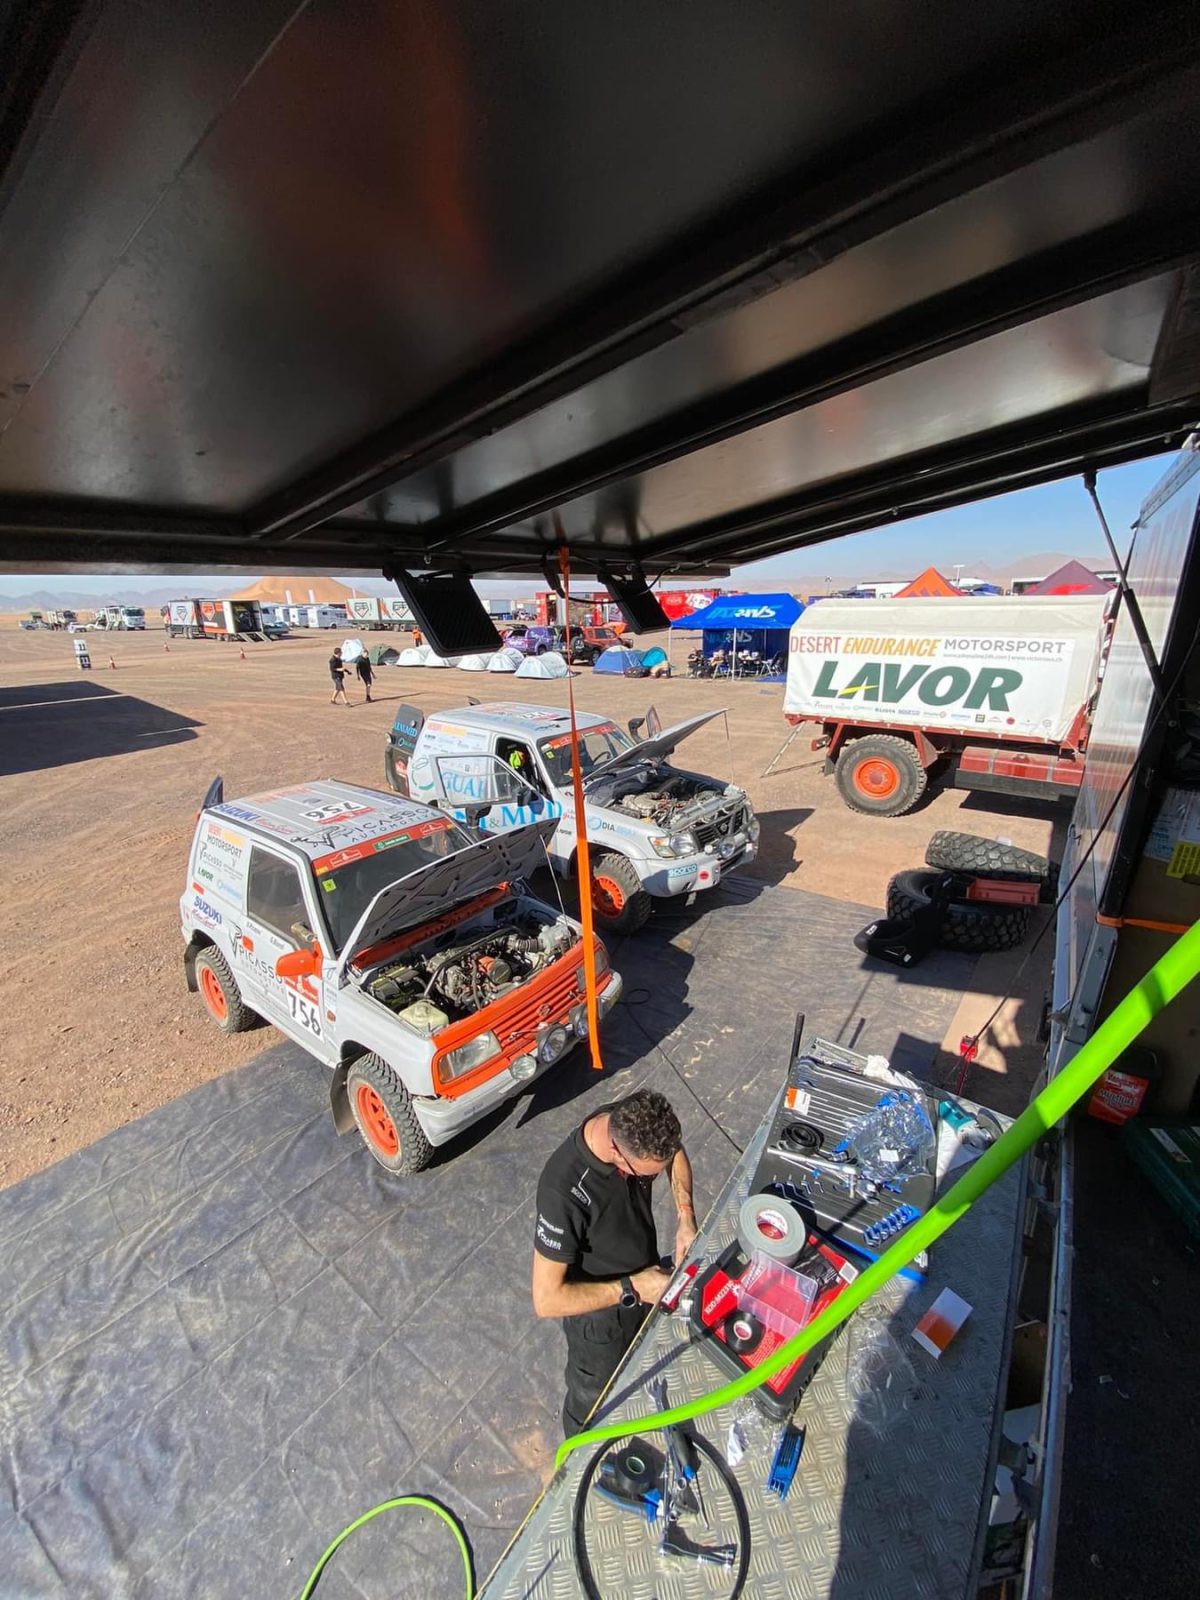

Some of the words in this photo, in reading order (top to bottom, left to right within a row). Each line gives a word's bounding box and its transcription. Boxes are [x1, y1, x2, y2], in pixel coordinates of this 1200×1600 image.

[790, 636, 840, 654] DESERT
[842, 637, 941, 657] ENDURANCE
[944, 639, 1066, 653] MOTORSPORT
[811, 661, 1023, 712] LAVOR
[194, 896, 222, 925] SUZUKI
[288, 992, 321, 1036] 756
